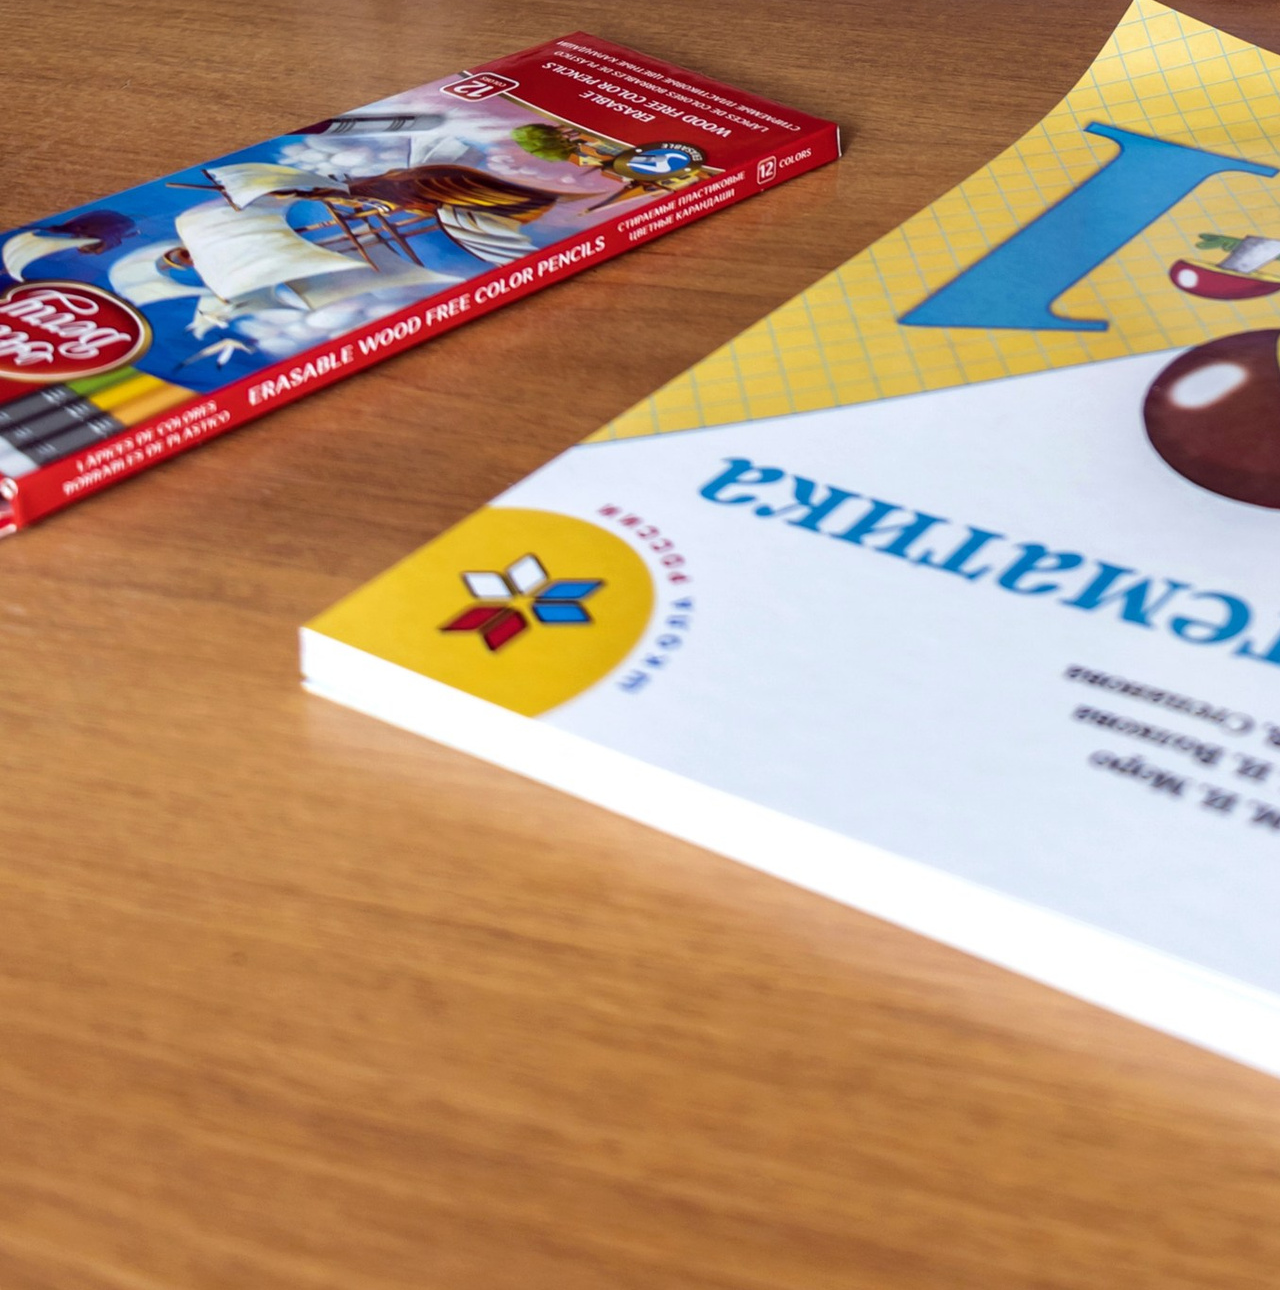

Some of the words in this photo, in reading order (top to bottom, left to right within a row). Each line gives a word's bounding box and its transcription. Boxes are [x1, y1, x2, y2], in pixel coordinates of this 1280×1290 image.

[453, 80, 495, 98] 12
[541, 61, 600, 91] PENCILS
[598, 81, 651, 110] COLOR
[579, 90, 656, 123] ERASABLE
[651, 101, 686, 119] FREE
[682, 113, 732, 138] WOOD
[759, 161, 774, 179] 12
[779, 148, 812, 170] COLORS
[617, 199, 677, 232] СТИРАЕМЫЕ
[678, 171, 746, 207] ПЛАСТИКОВЫЕ
[629, 213, 675, 241] ЦВЕТНЫЕ
[675, 188, 736, 221] КАРАНДАШИ
[897, 121, 1280, 332] 1
[247, 343, 355, 407] ERASABLE
[358, 315, 422, 356] WOOD
[425, 292, 471, 327] FREE
[474, 266, 534, 305] COLOR
[536, 234, 606, 278] PENCILS
[598, 503, 692, 585] РОССИИ
[1064, 664, 1256, 737] Степанова
[1072, 703, 1224, 766] Волкова
[1087, 748, 1188, 799] Моро
